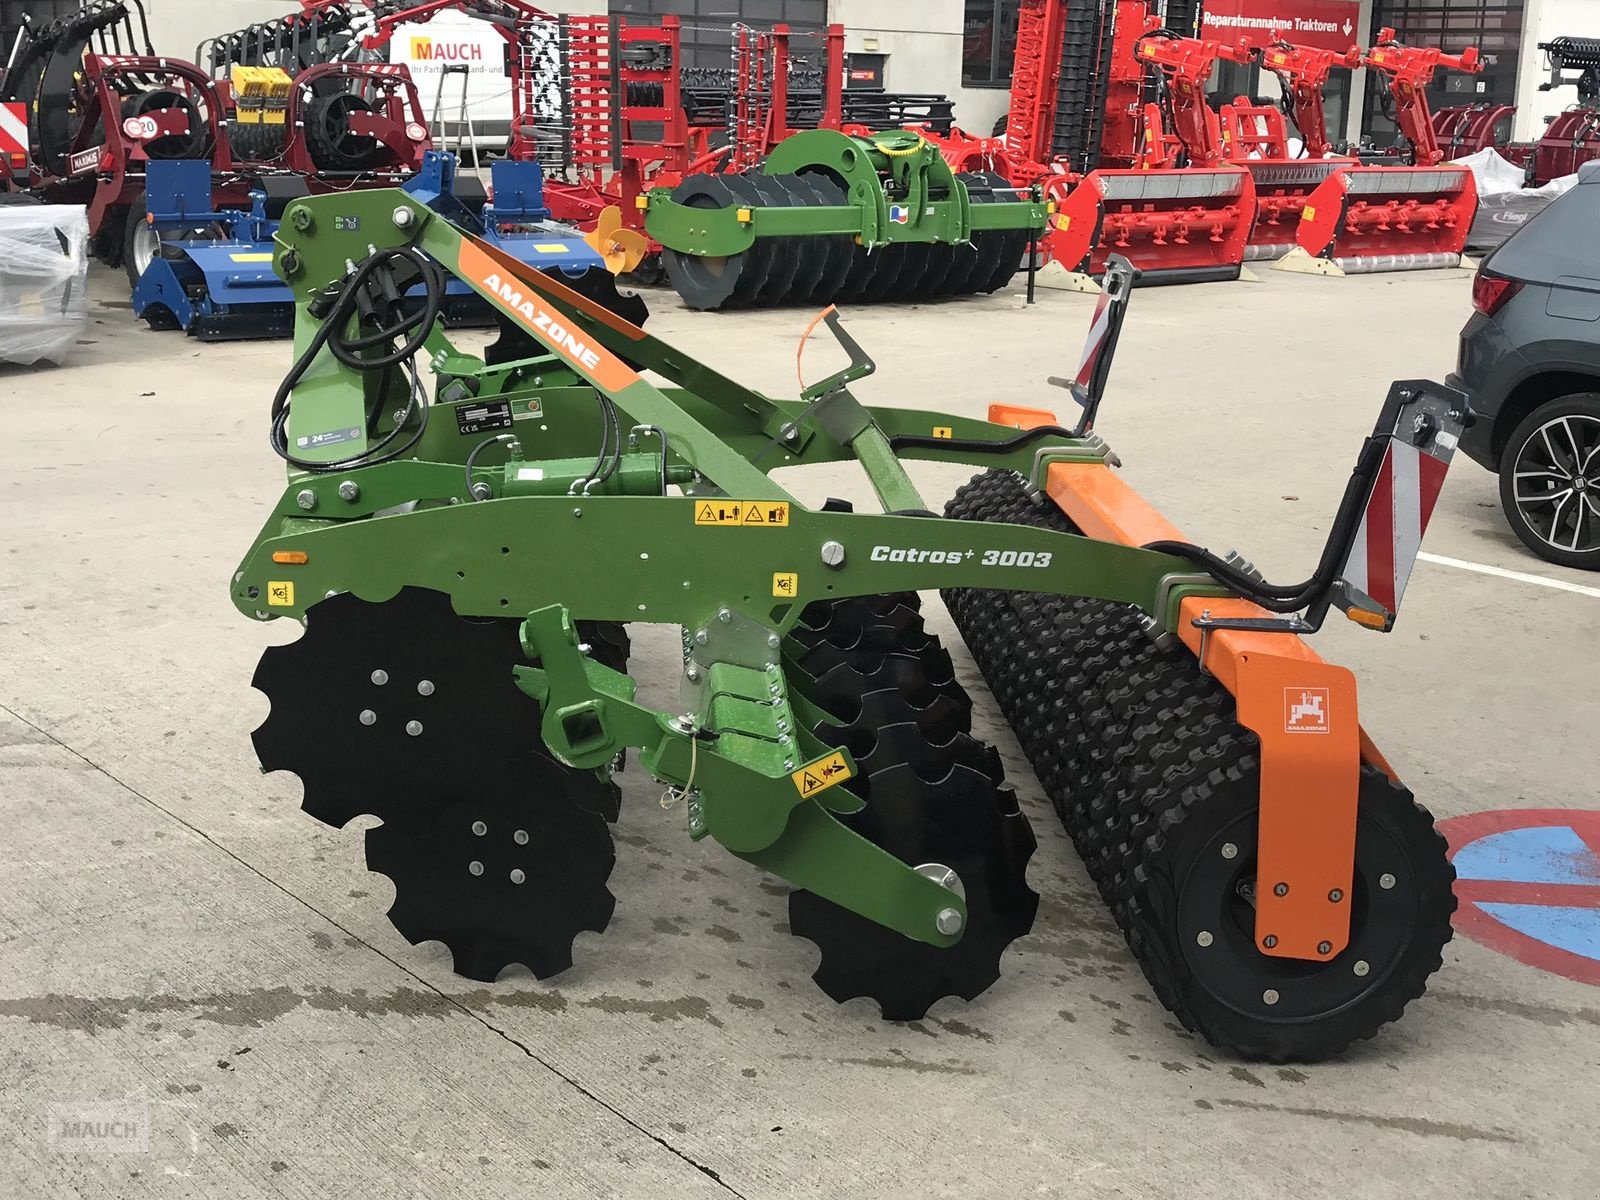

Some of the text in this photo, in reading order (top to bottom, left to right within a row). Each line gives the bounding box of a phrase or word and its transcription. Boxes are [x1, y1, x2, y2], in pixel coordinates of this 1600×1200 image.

[1203, 11, 1292, 30] Reparaturannahme
[1295, 18, 1338, 32] Traktoren
[416, 43, 482, 60] MAUCH
[411, 65, 421, 73] Ihr
[489, 65, 502, 73] und
[483, 273, 601, 370] AMAZONE
[312, 435, 323, 443] 24
[981, 550, 1053, 568] 3003
